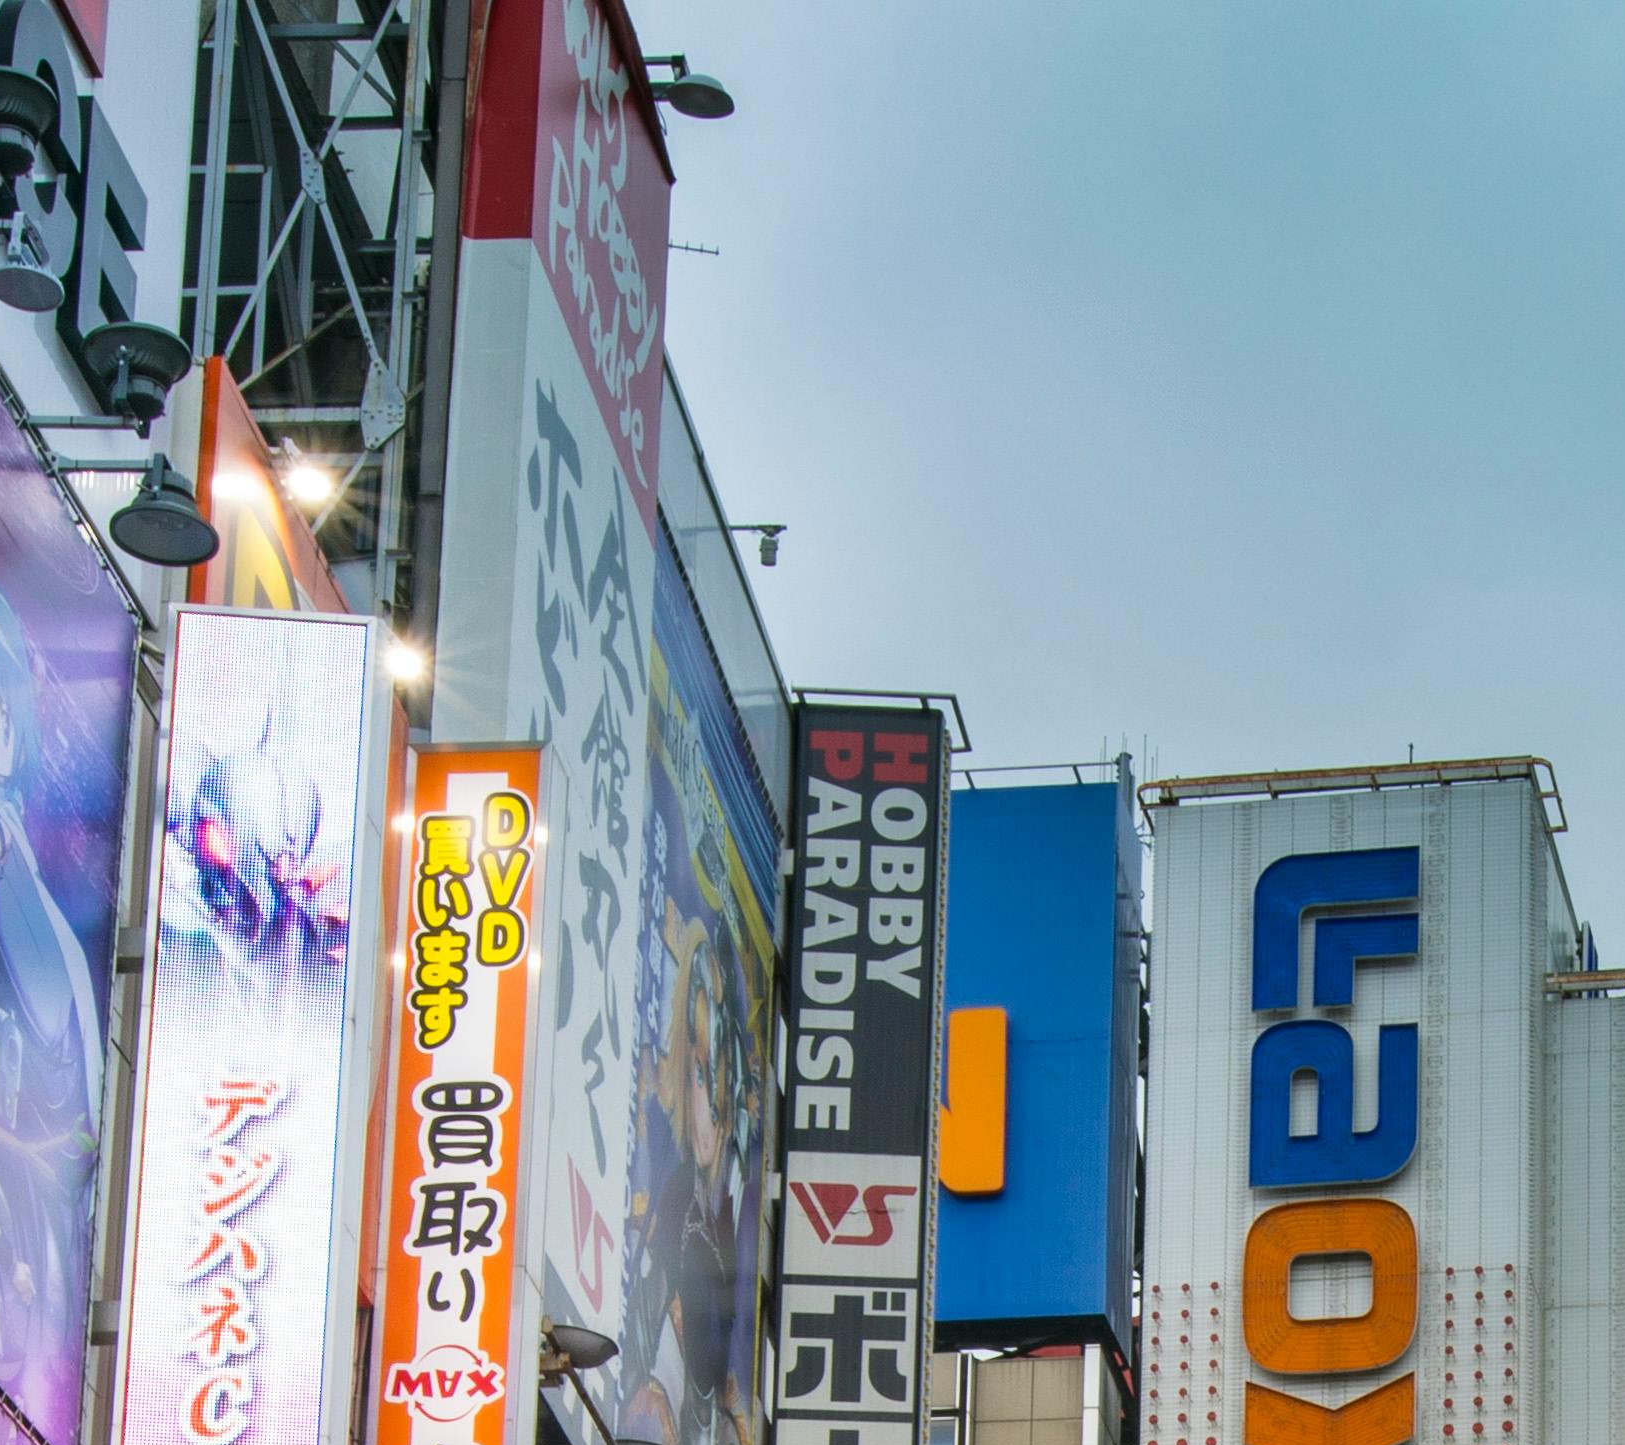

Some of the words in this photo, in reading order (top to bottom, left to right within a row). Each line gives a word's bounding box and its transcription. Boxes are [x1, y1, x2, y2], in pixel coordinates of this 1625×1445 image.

[408, 814, 475, 1051] 買います
[475, 791, 533, 967] DVD
[792, 729, 865, 1132] PARADISE
[864, 732, 929, 1000] HOBBY
